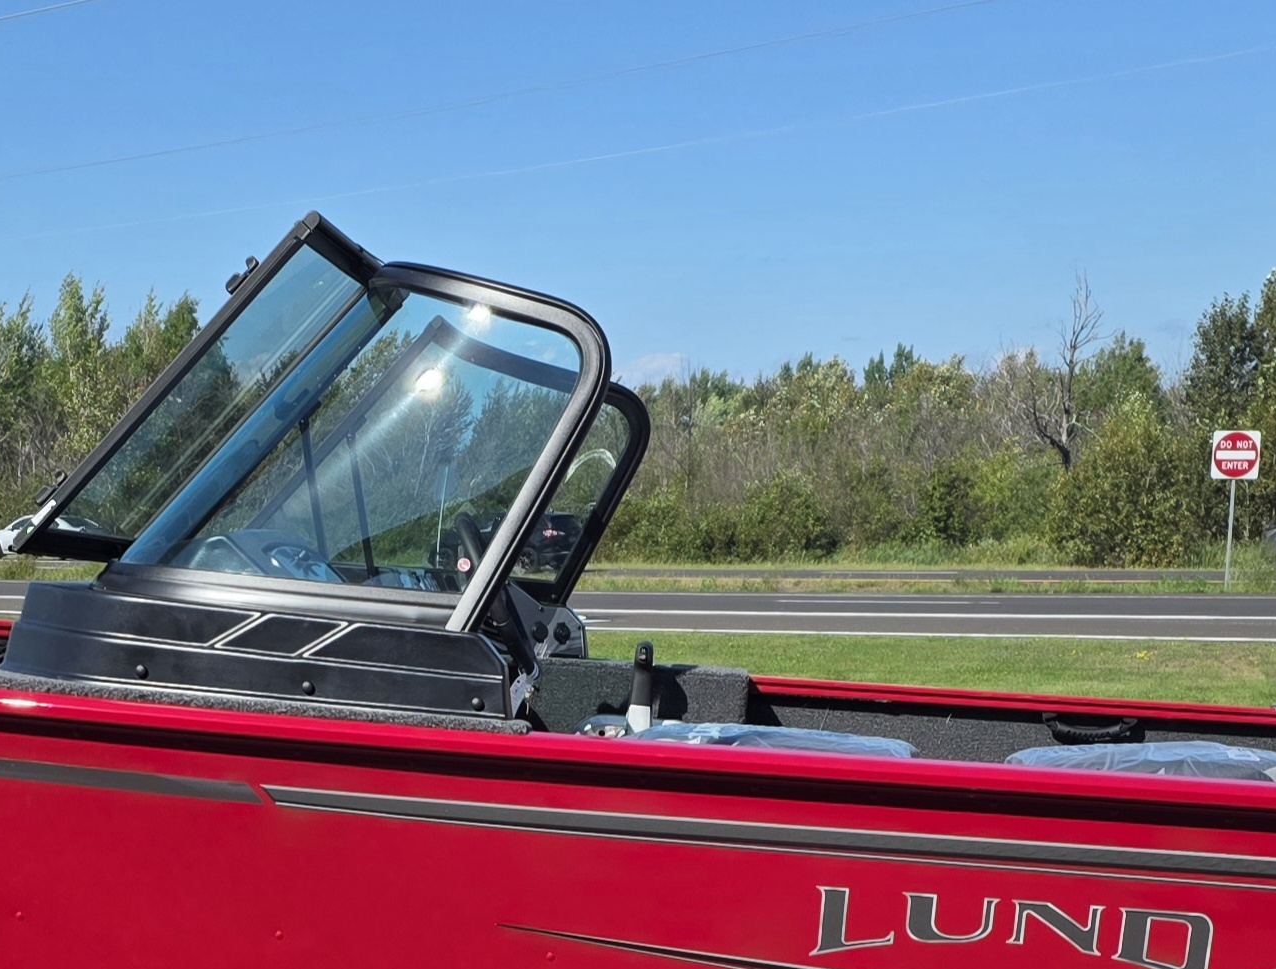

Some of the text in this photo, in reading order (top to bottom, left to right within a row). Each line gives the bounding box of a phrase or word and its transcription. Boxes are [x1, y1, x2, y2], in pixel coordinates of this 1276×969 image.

[1220, 440, 1253, 449] DO NOT
[1221, 461, 1249, 470] ENTER
